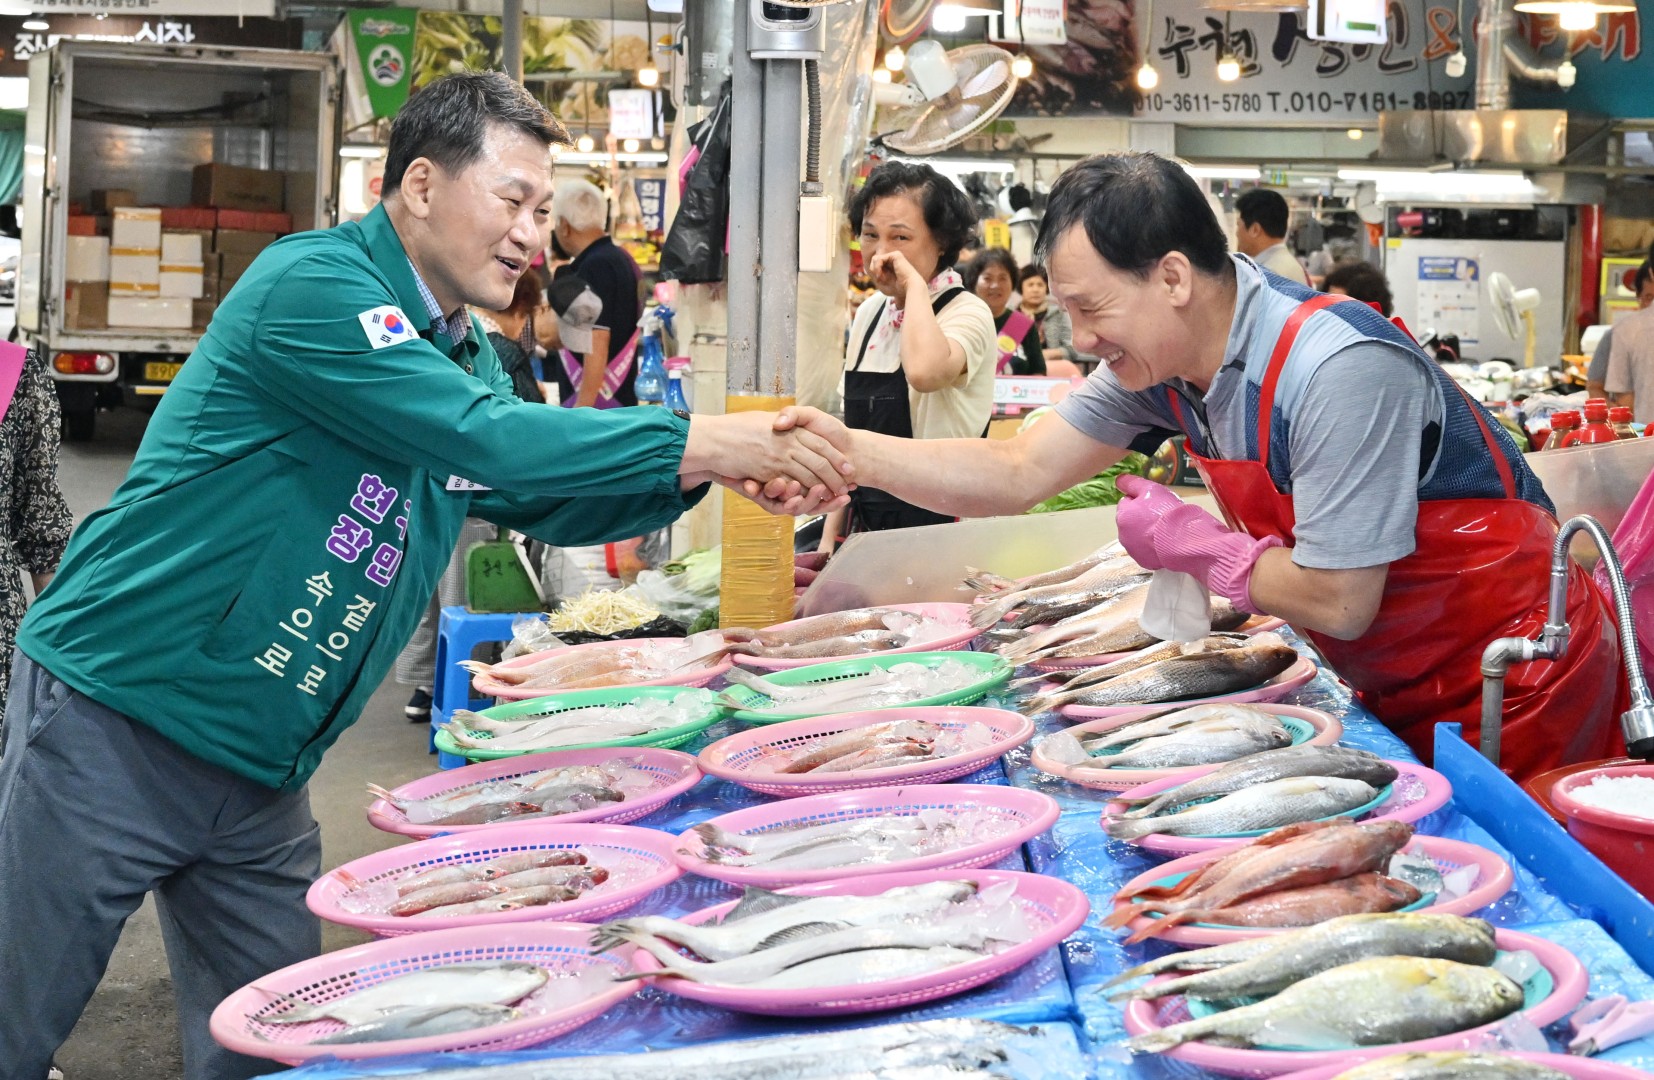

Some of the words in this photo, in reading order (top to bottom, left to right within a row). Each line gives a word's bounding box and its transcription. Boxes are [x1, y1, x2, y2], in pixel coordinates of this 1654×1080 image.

[326, 473, 398, 563] 현장
[253, 571, 334, 678] 속으로
[296, 594, 377, 696] 곁으로
